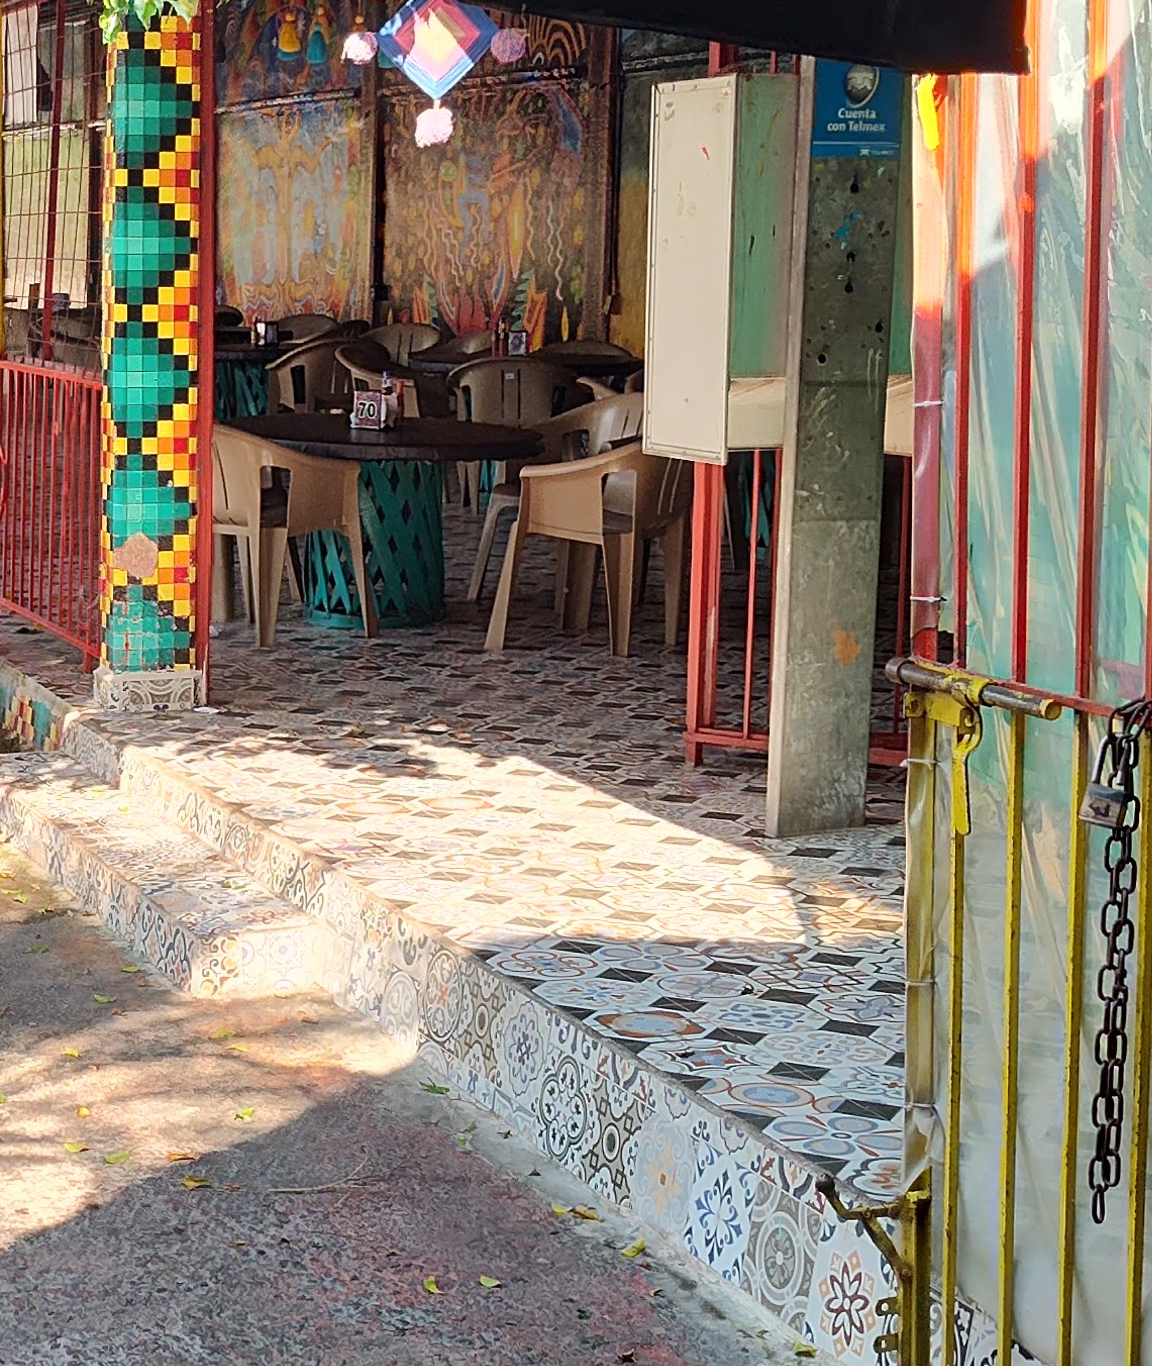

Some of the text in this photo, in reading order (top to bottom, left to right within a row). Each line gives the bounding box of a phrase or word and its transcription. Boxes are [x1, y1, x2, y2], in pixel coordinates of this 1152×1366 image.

[838, 108, 877, 119] Cuenta
[827, 120, 886, 132] con Telmex
[358, 401, 377, 419] 70
